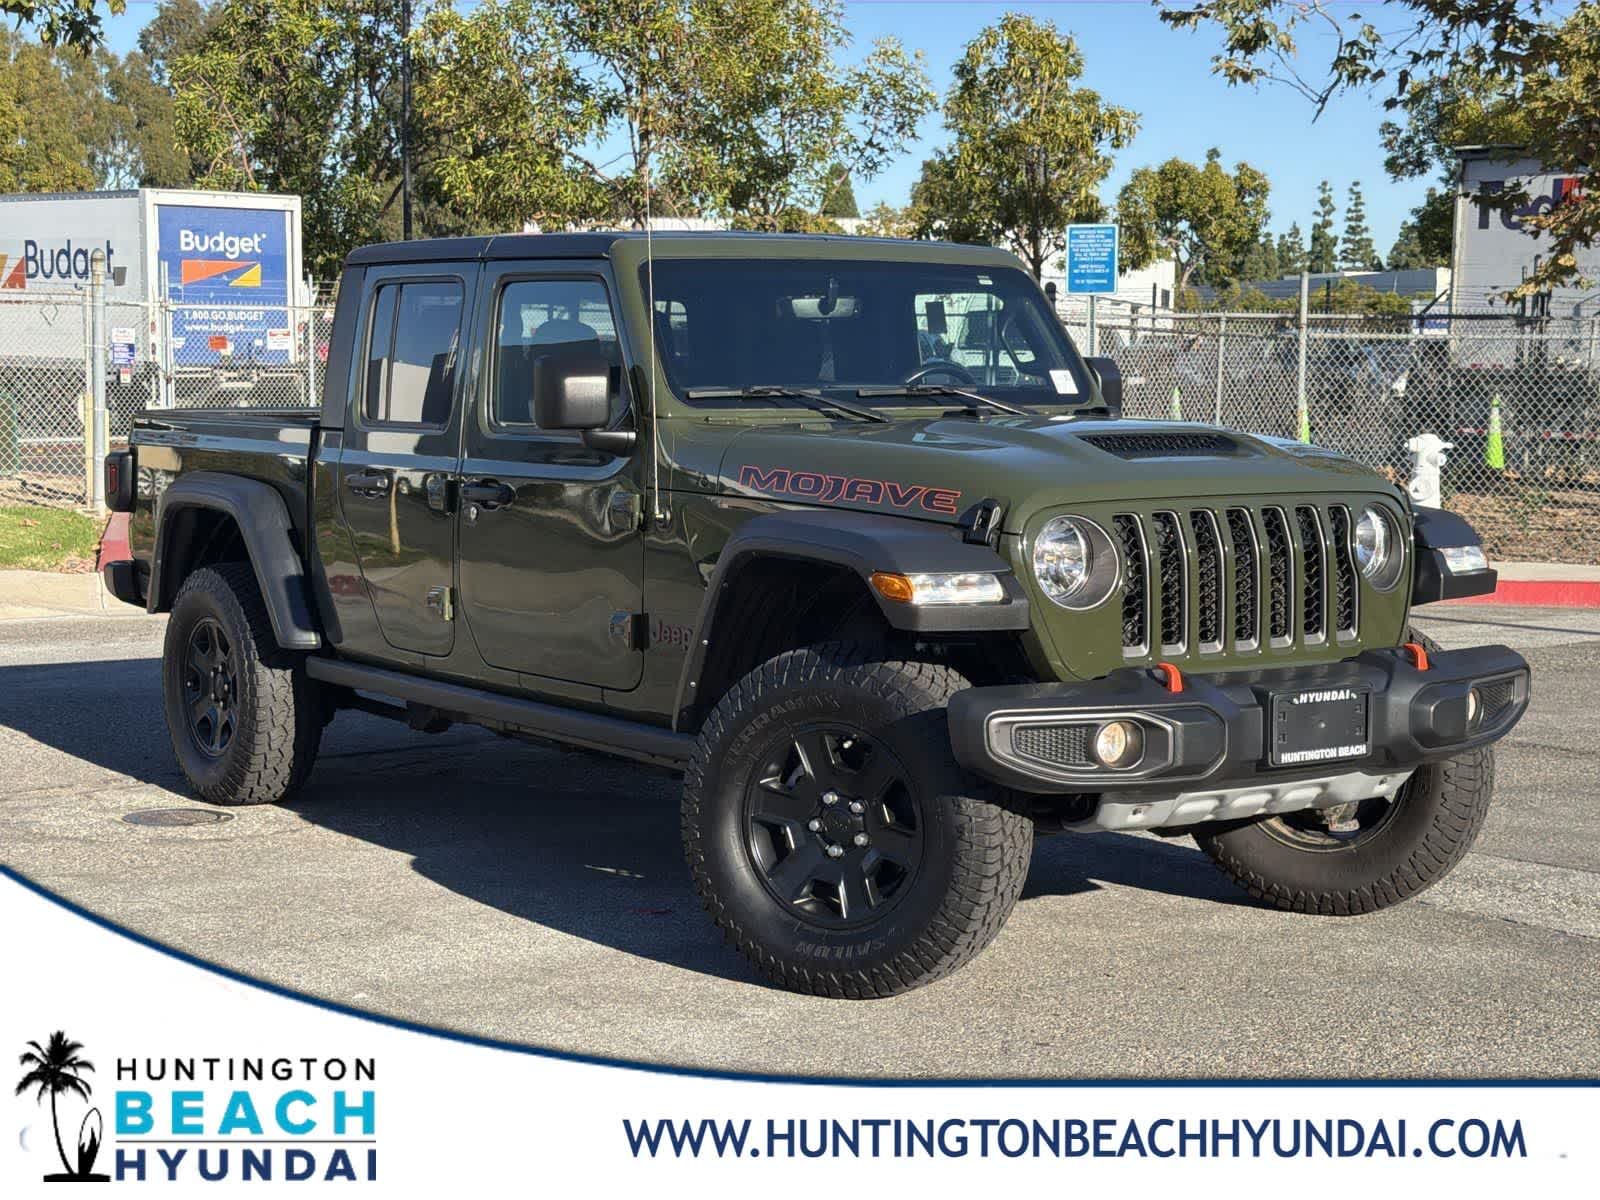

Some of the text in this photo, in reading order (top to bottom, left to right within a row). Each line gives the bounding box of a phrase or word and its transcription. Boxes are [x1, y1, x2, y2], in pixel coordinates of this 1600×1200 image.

[180, 229, 263, 259] Budget
[24, 239, 114, 290] Budgt
[739, 465, 961, 514] MOJAVE
[655, 620, 693, 654] Jeep
[1299, 689, 1350, 704] HYUNDAI
[1281, 744, 1367, 764] HUNTINGTON BEACH
